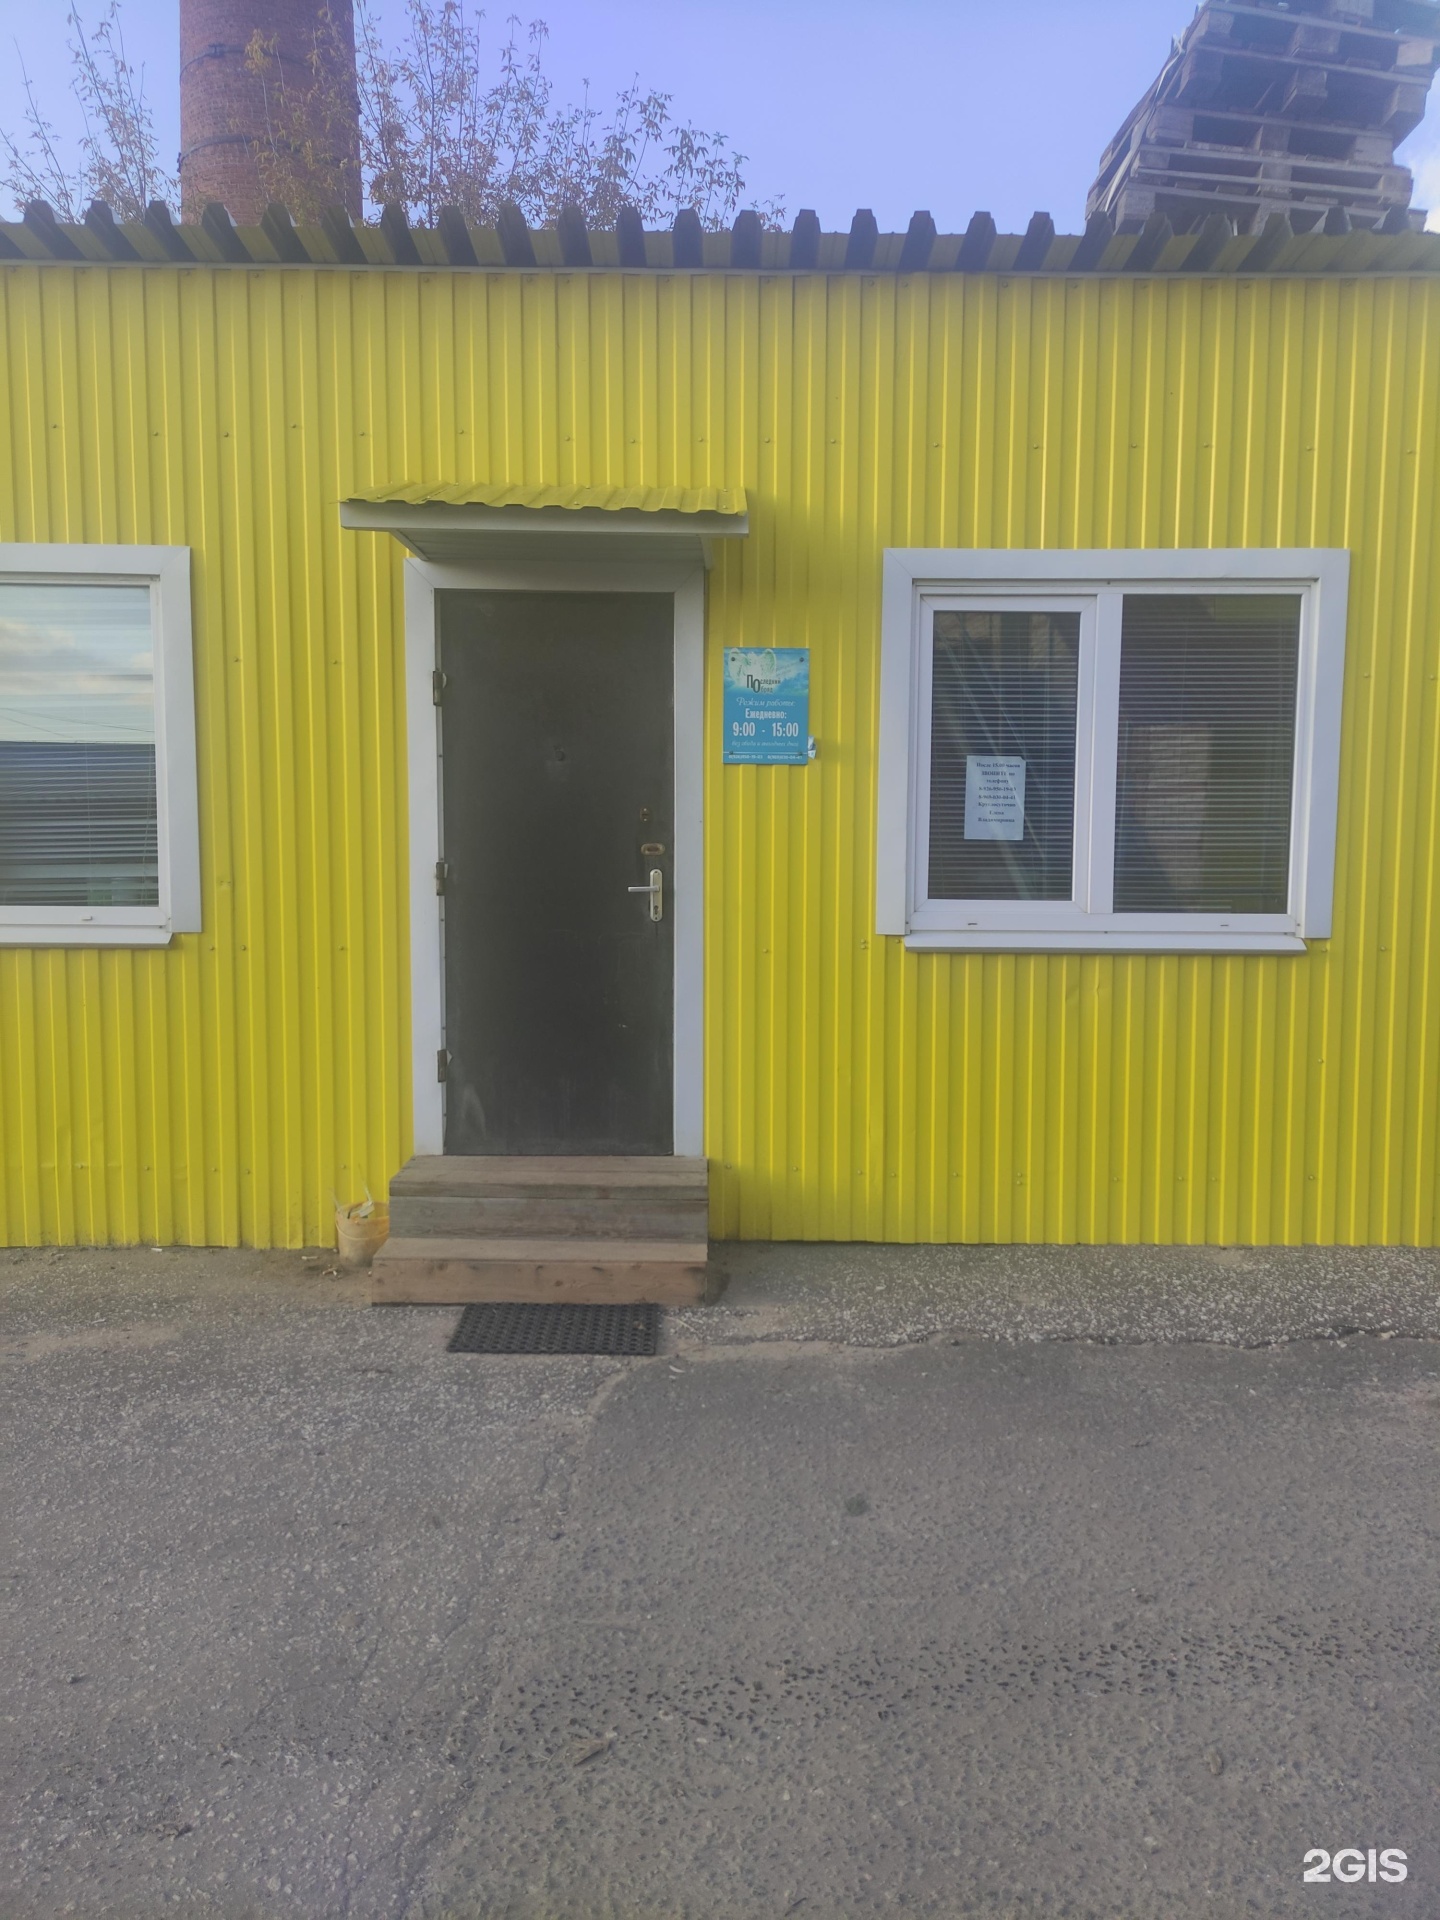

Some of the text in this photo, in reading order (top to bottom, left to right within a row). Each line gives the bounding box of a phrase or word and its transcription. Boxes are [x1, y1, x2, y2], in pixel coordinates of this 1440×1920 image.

[745, 708, 788, 720] Ежедневно:
[732, 721, 756, 737] 9:00
[772, 722, 799, 737] 15:00
